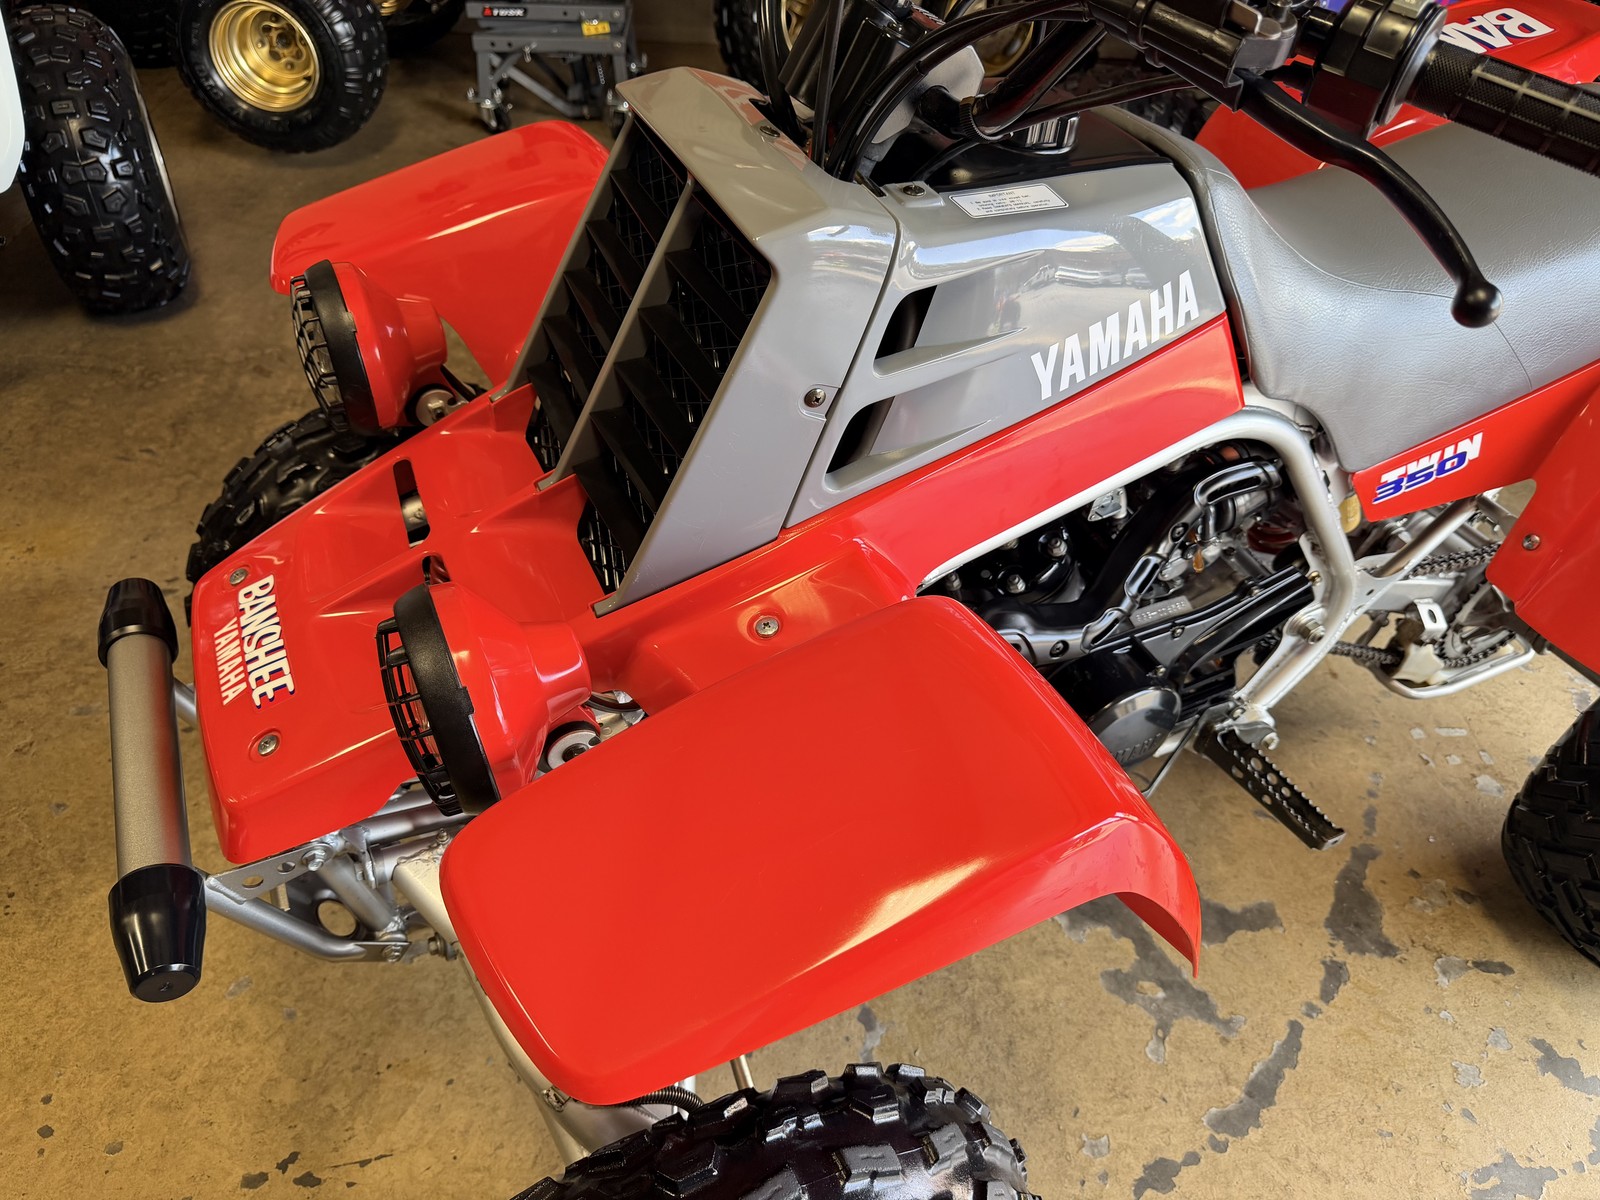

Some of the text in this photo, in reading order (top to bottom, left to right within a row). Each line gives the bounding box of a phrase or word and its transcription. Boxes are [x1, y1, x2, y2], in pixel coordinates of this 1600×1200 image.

[1030, 269, 1200, 401] YAMAHA
[1372, 451, 1469, 505] 350
[1380, 432, 1483, 484] TWIN
[213, 616, 248, 706] YAMAHA
[238, 574, 295, 709] BANSHEE
